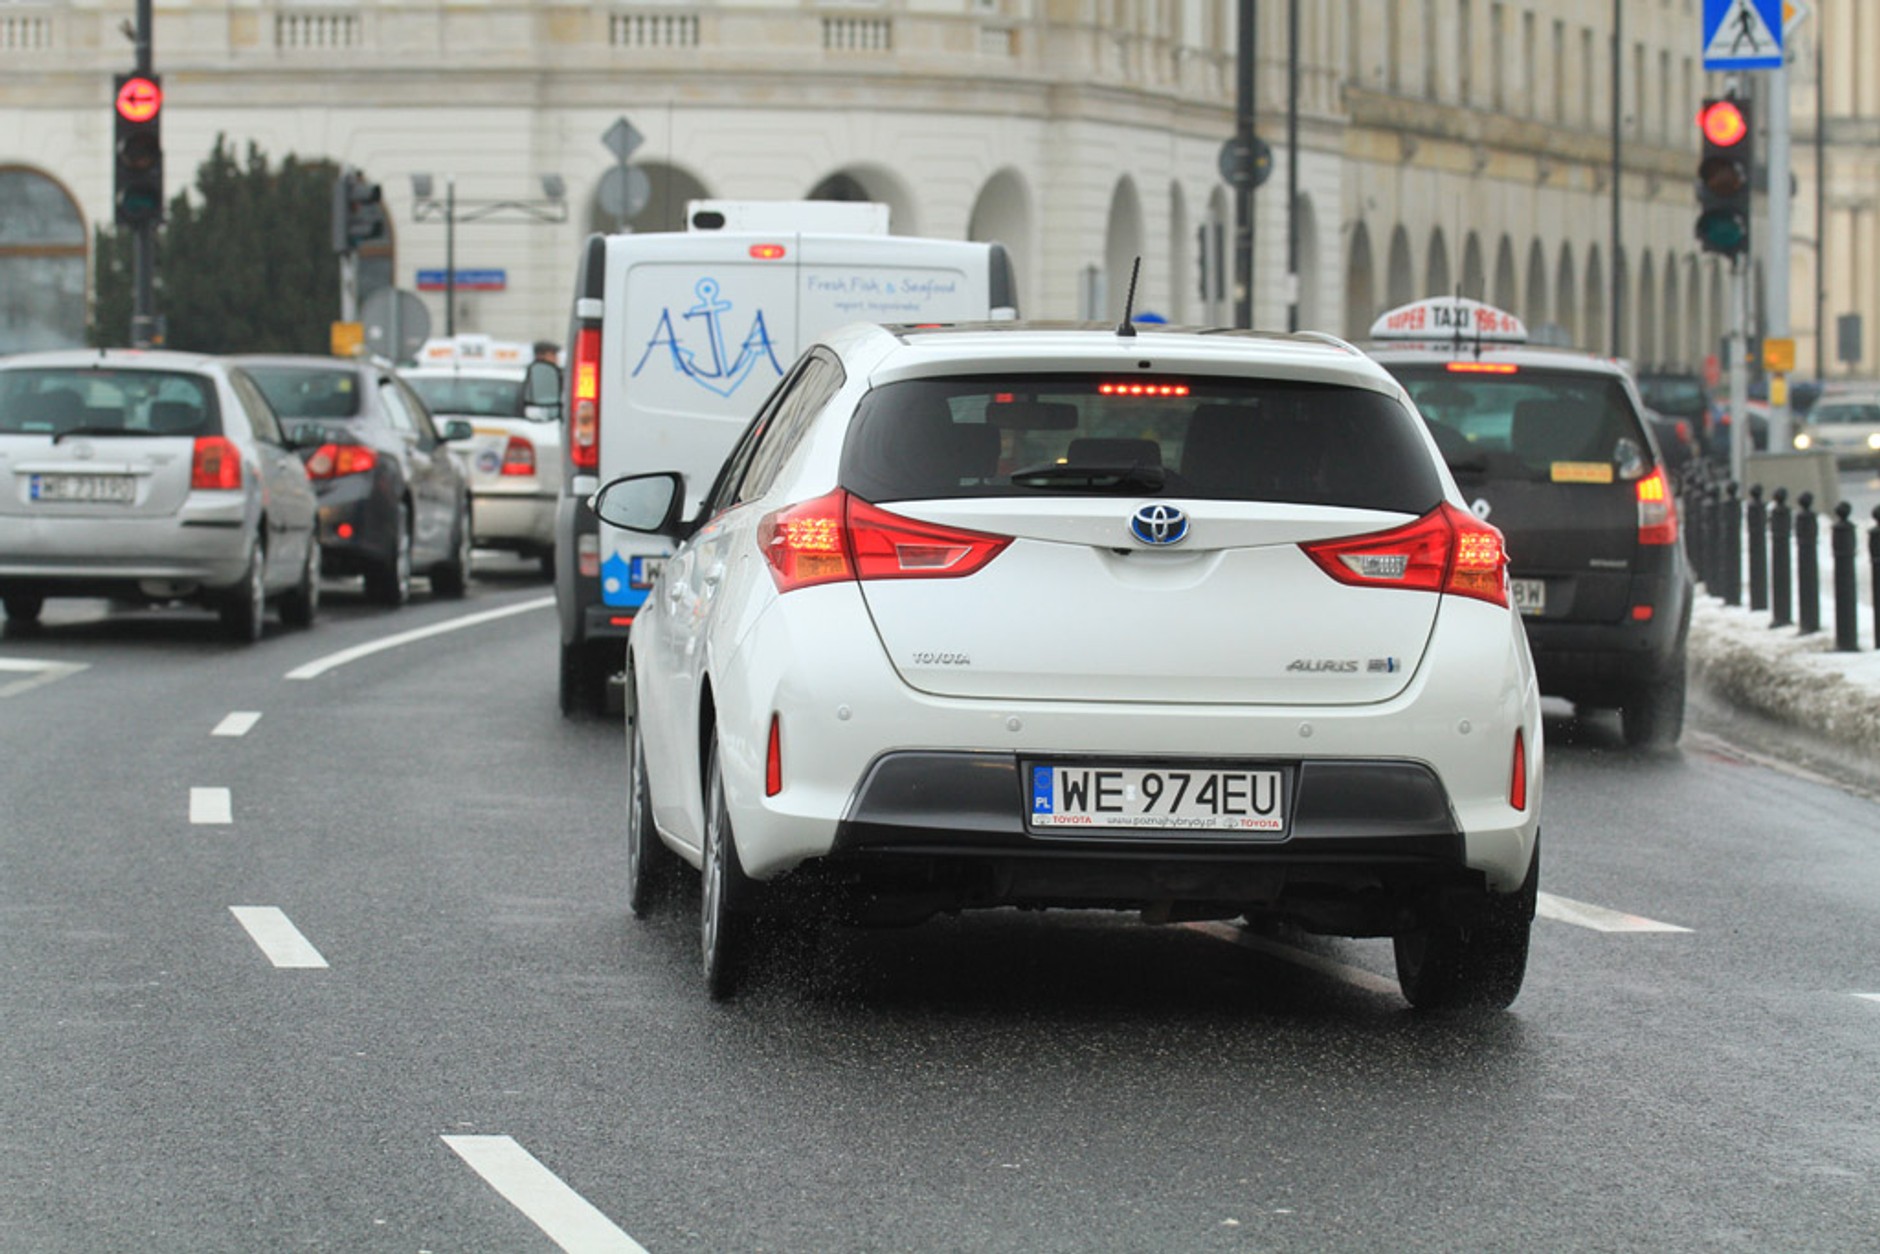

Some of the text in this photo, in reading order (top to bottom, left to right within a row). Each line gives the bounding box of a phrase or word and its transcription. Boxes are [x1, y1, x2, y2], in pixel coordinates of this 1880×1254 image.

[808, 276, 847, 292] Fresh
[851, 277, 879, 292] Fish
[901, 278, 956, 300] Seafood
[1387, 307, 1426, 331] SUPER
[1432, 306, 1469, 328] TAXI
[912, 652, 970, 665] TOYOTA
[1286, 659, 1358, 673] AURIS
[1061, 771, 1276, 815] WE 974EU
[1035, 797, 1051, 809] PL
[1053, 815, 1279, 829] TOYOTA www.poznajhybrydy.pl TOYOTA
